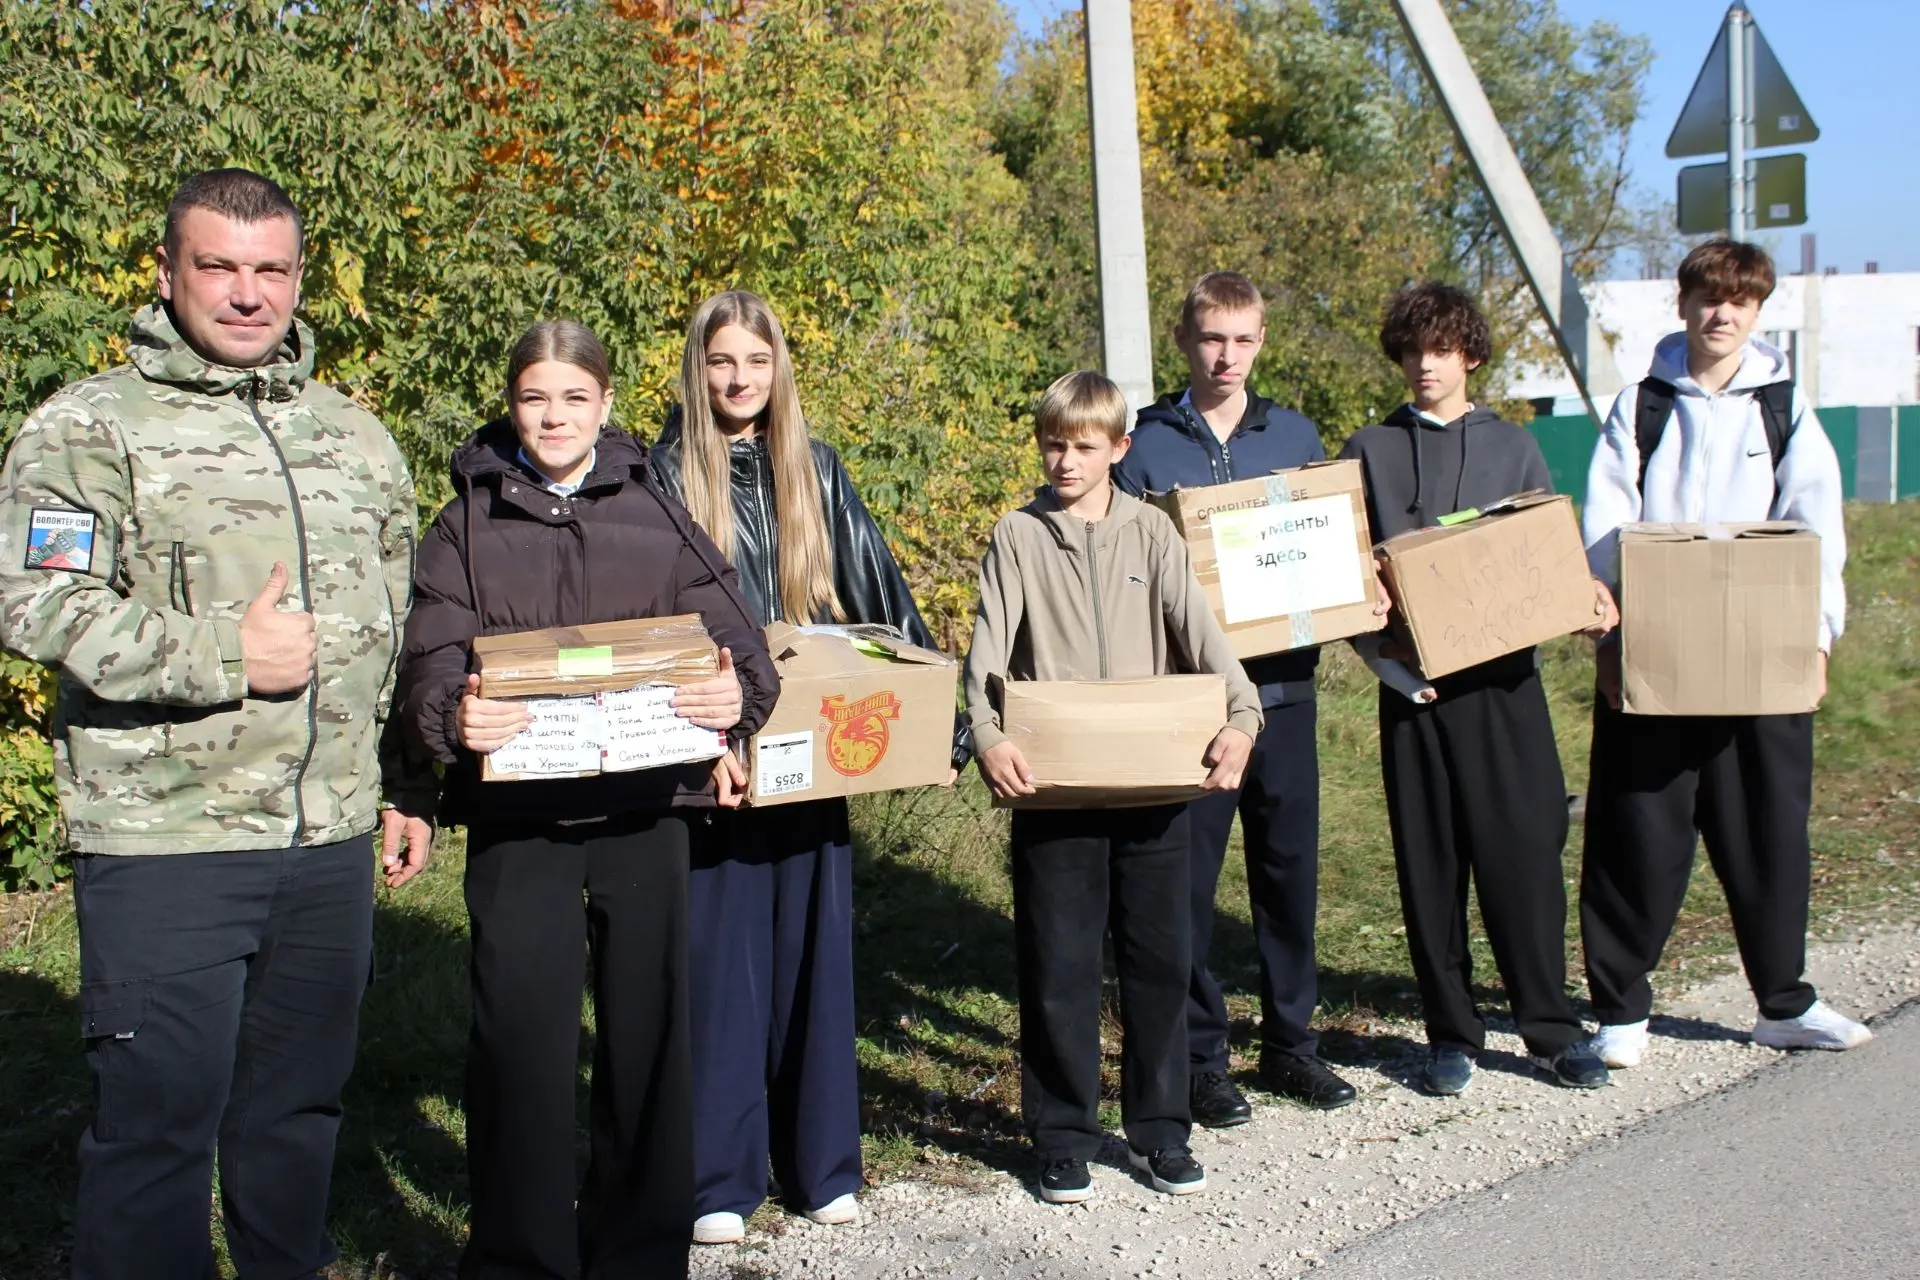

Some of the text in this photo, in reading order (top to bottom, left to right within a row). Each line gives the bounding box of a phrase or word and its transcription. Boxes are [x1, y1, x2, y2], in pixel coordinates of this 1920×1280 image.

[75, 519, 91, 528] СВО
[1256, 515, 1329, 541] ументы
[1255, 549, 1307, 568] здесь
[775, 772, 804, 787] 8255
